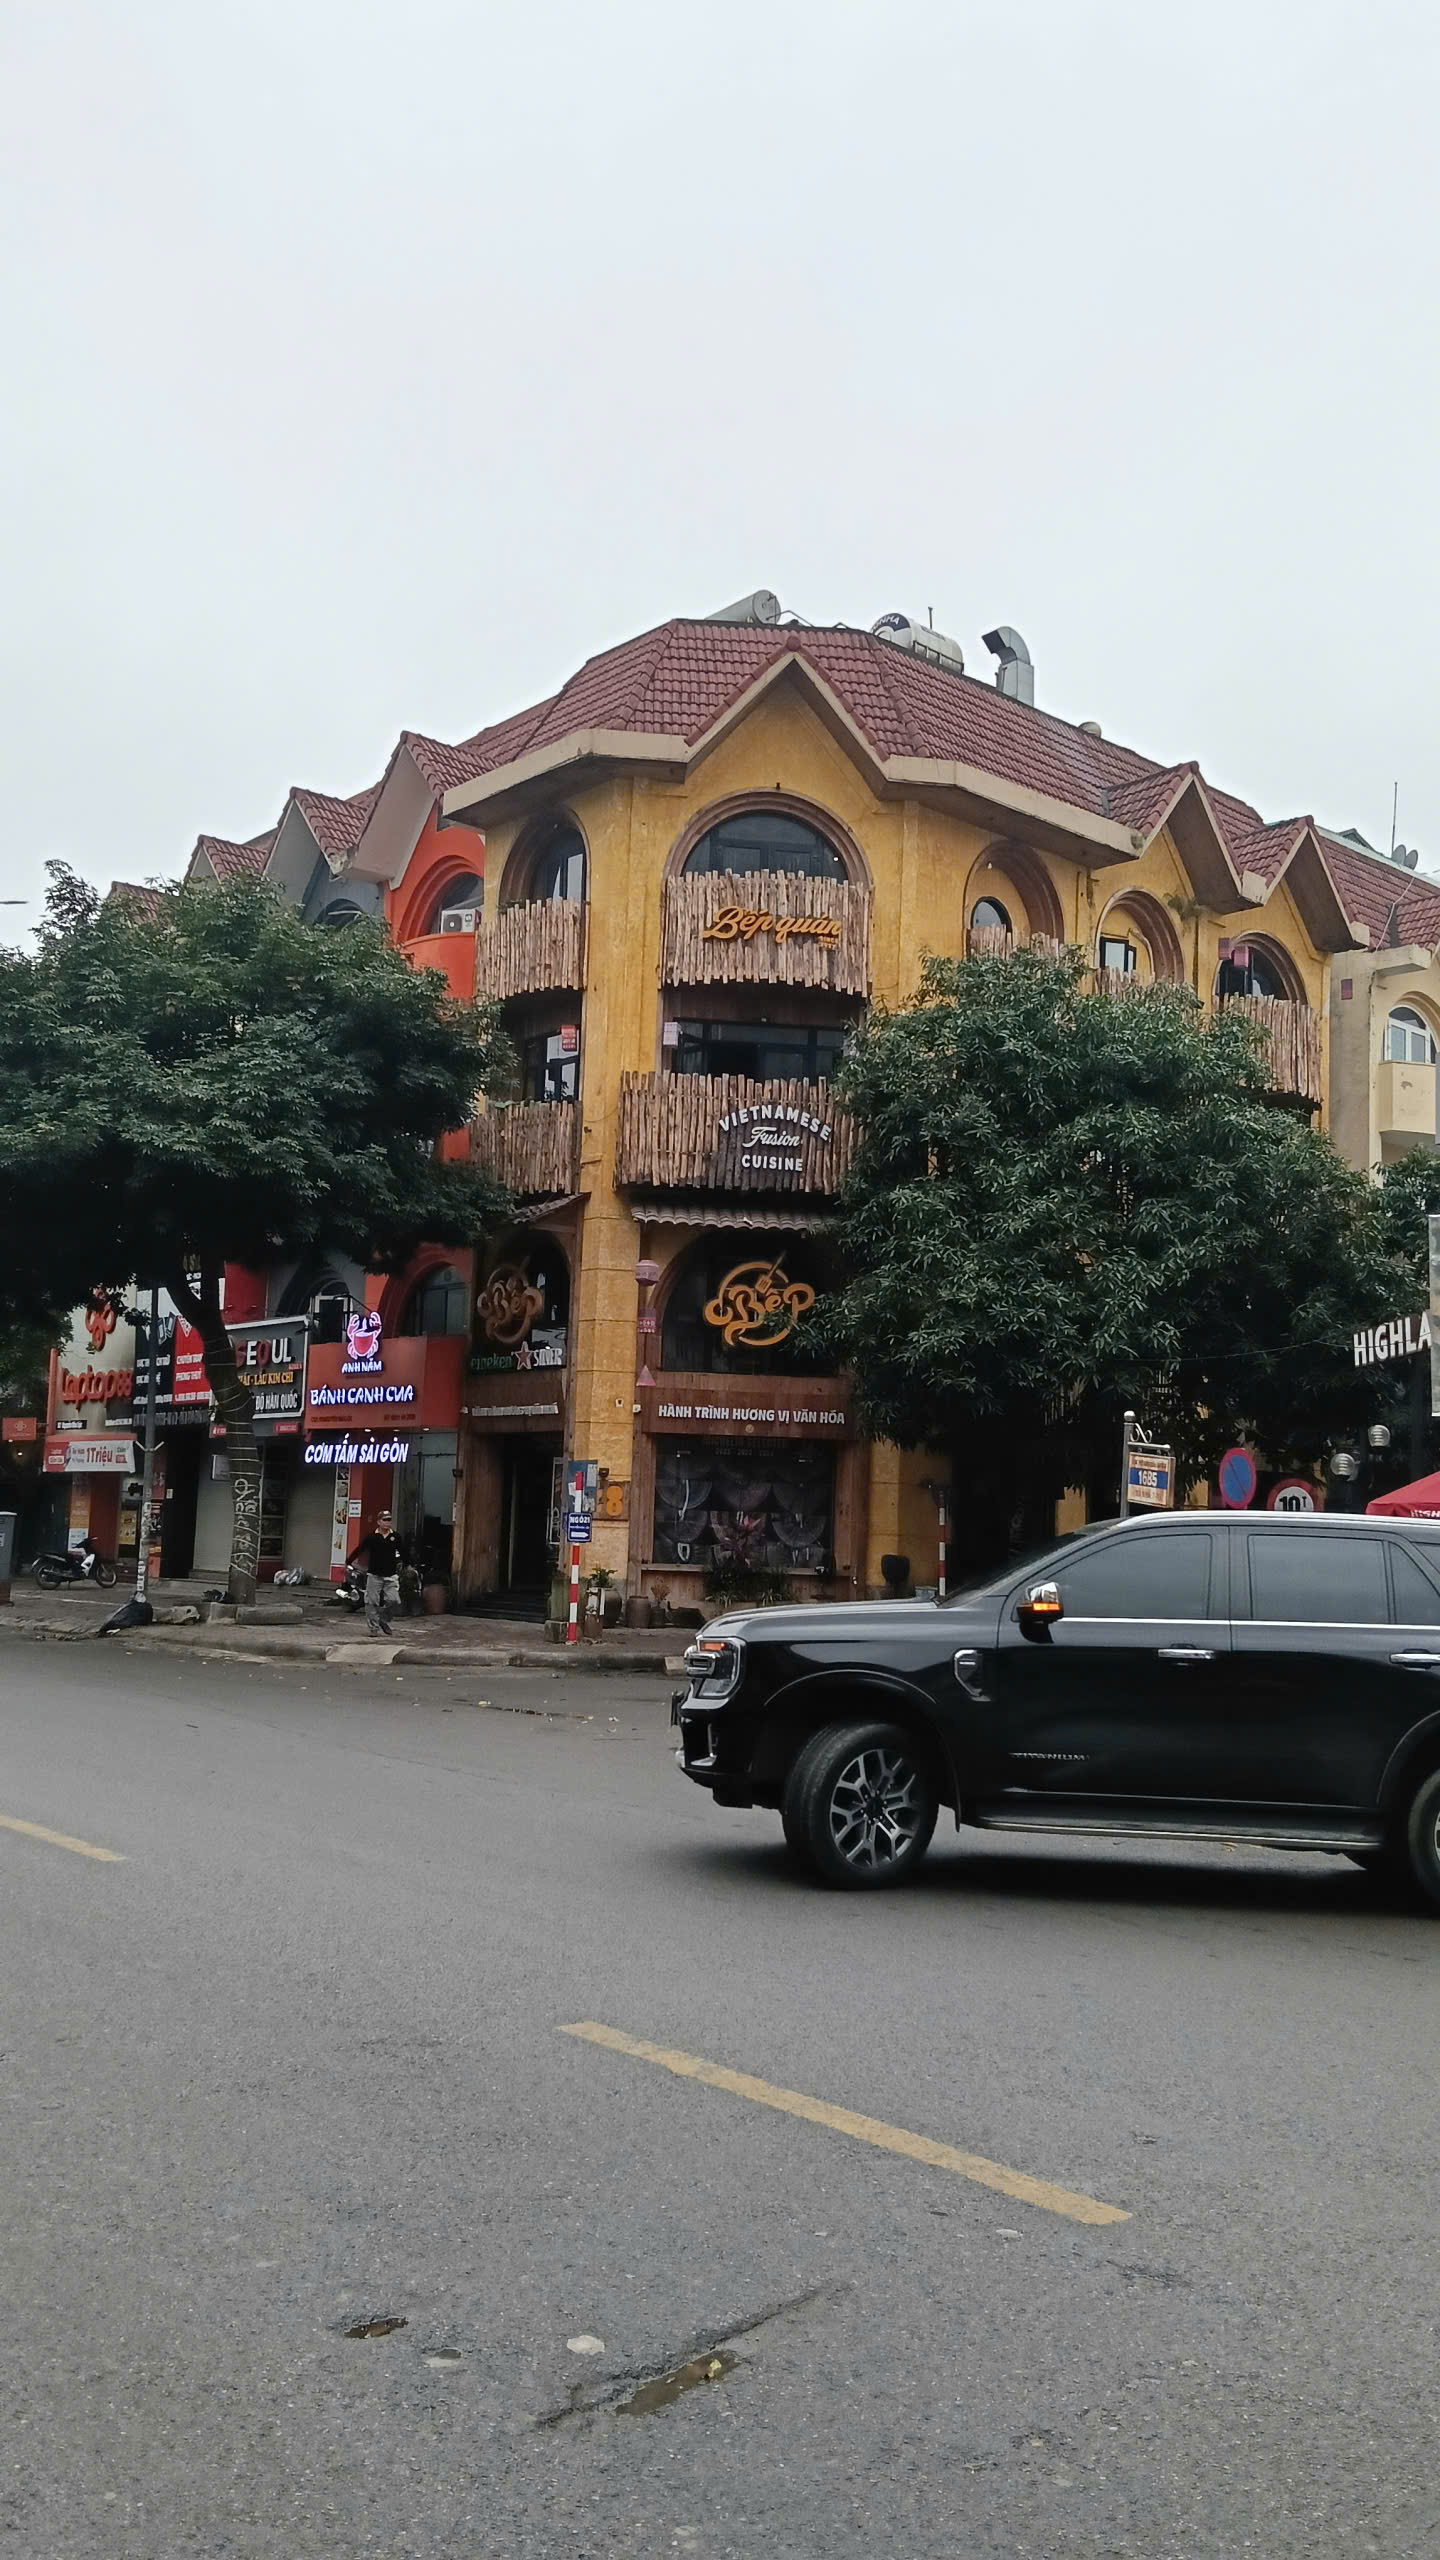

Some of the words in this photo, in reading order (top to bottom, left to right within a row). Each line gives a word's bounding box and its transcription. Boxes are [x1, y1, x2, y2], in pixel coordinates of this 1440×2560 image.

[703, 905, 774, 940] Bếp
[775, 914, 841, 944] quán
[719, 1104, 831, 1142] VIETNAMESE
[742, 1126, 801, 1148] Fusion
[741, 1154, 803, 1172] CUISINE
[342, 1362, 361, 1374] ANH
[310, 1385, 346, 1405] BÁNH
[347, 1387, 384, 1404] CANH
[386, 1384, 414, 1402] CUA
[658, 1403, 692, 1418] HÀNH
[694, 1404, 729, 1420] TRÌNH
[732, 1408, 775, 1422] HƯƠNG
[778, 1410, 790, 1424] VỊ
[793, 1408, 817, 1423] VĂN
[819, 1409, 845, 1425] HÓA
[304, 1441, 334, 1463] CƠM
[334, 1433, 359, 1463] TẤM
